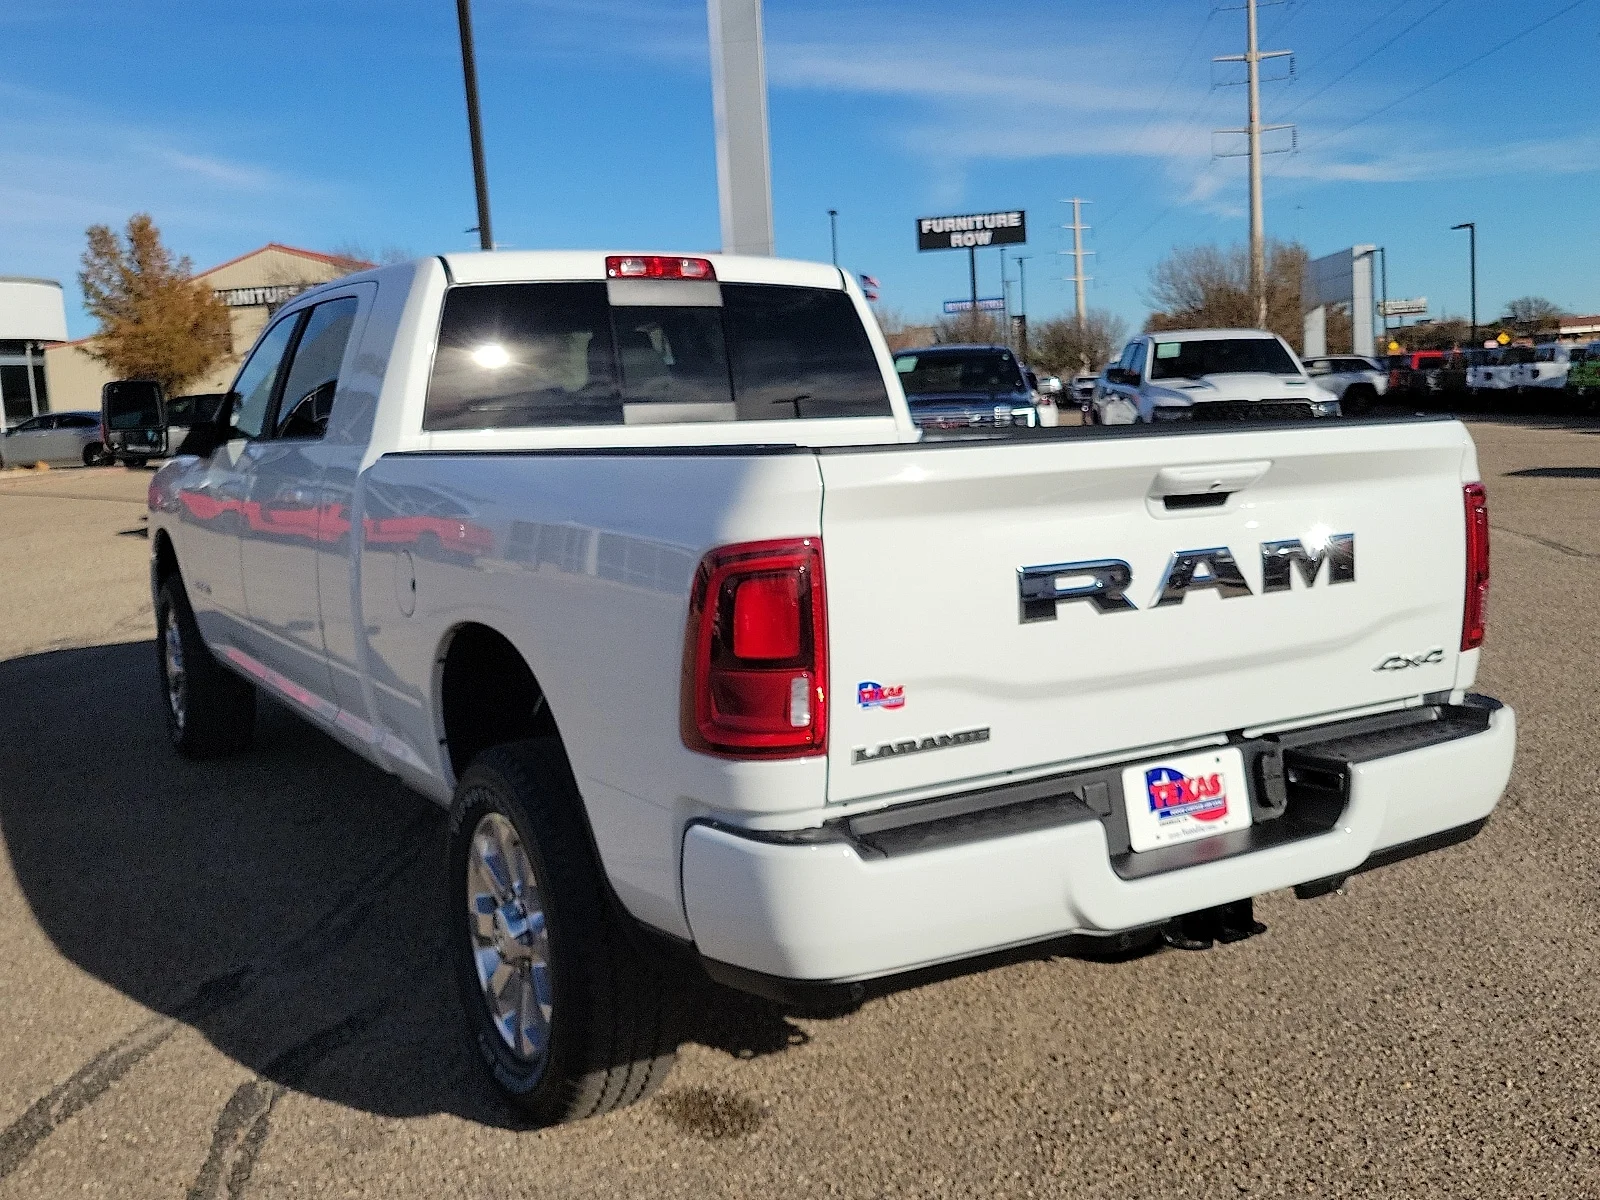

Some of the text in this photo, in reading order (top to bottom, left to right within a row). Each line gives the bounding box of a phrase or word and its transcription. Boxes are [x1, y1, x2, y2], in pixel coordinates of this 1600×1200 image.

[921, 212, 1022, 234] FURNITURE
[950, 230, 993, 248] ROW
[1017, 532, 1356, 625] RAM
[851, 727, 991, 765] LARAMIE
[1150, 773, 1222, 809] TEXAS
